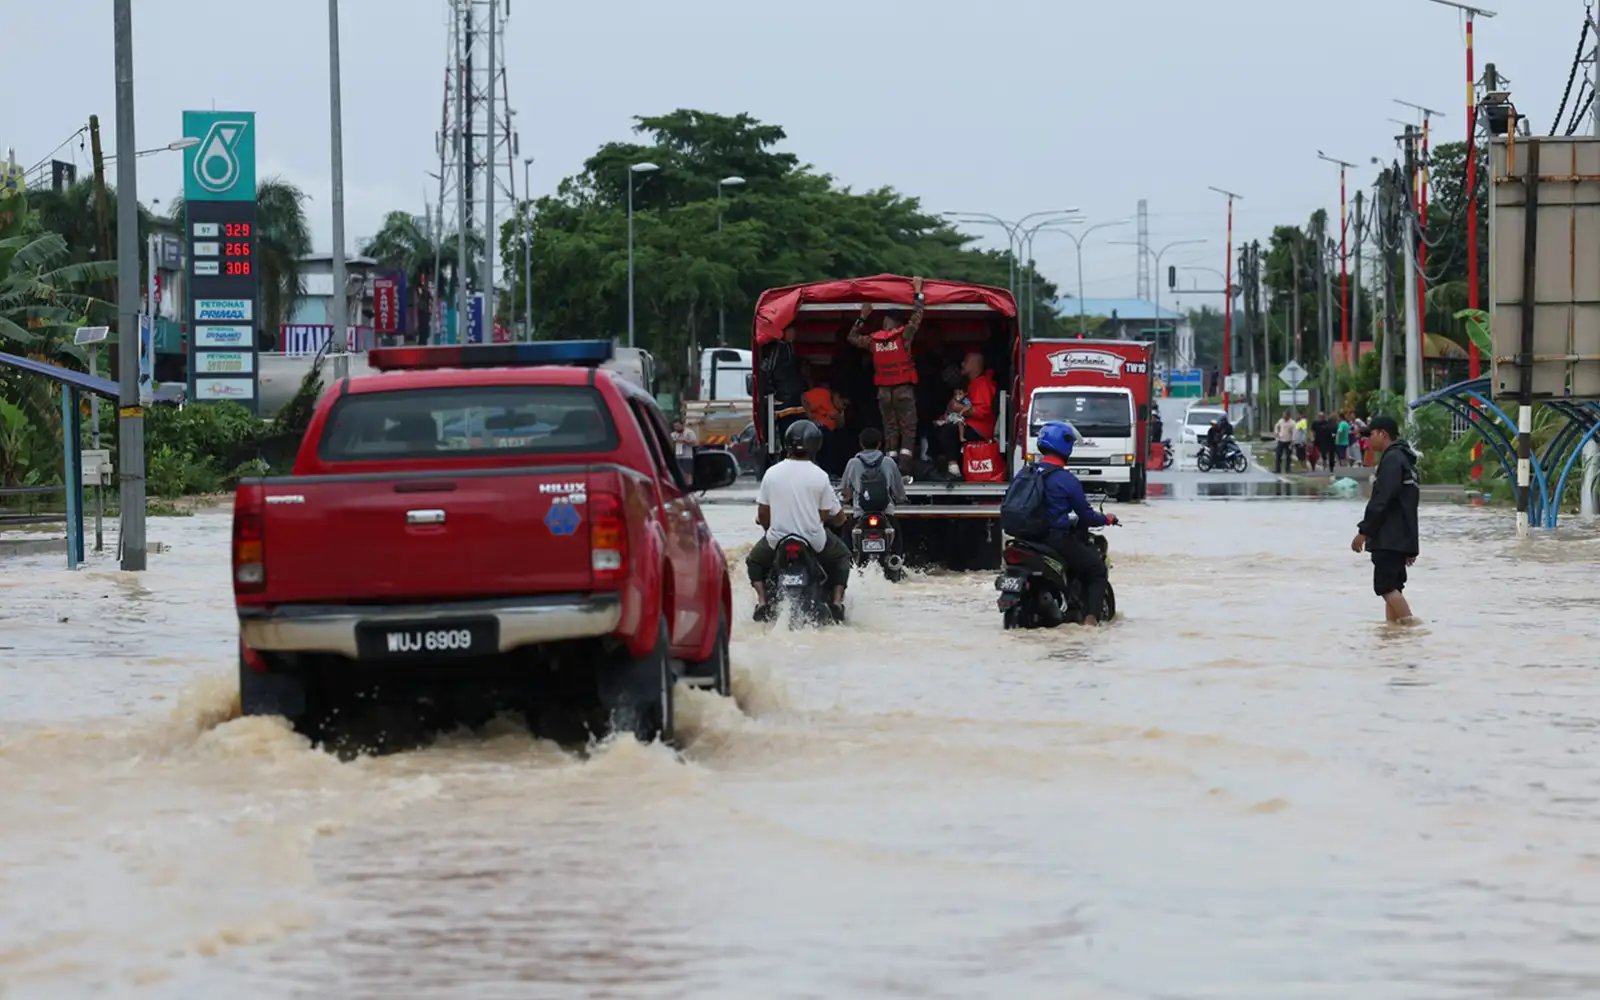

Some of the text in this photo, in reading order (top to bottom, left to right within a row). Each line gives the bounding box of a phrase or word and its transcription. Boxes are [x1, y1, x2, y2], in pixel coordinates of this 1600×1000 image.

[200, 310, 245, 318] PRIMAX
[539, 483, 586, 493] HILUX
[387, 630, 472, 652] WUJ 6909
